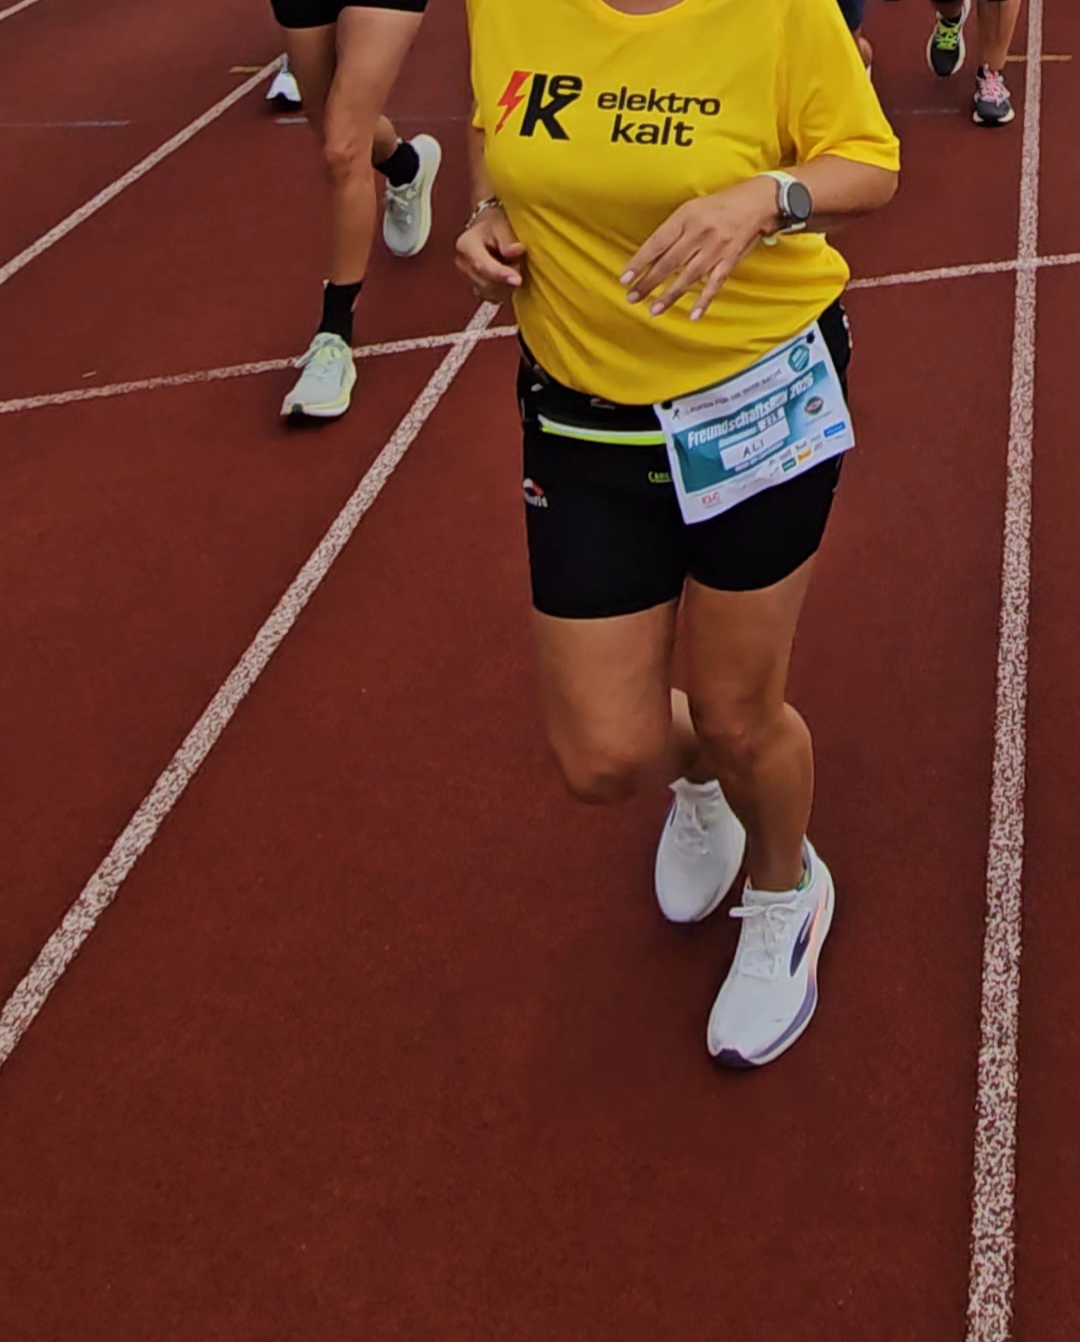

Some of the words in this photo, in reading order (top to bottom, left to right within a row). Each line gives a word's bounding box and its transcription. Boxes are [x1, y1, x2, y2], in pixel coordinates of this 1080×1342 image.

[597, 86, 721, 116] elektro
[610, 113, 694, 147] kalt
[743, 439, 765, 459] ALI
